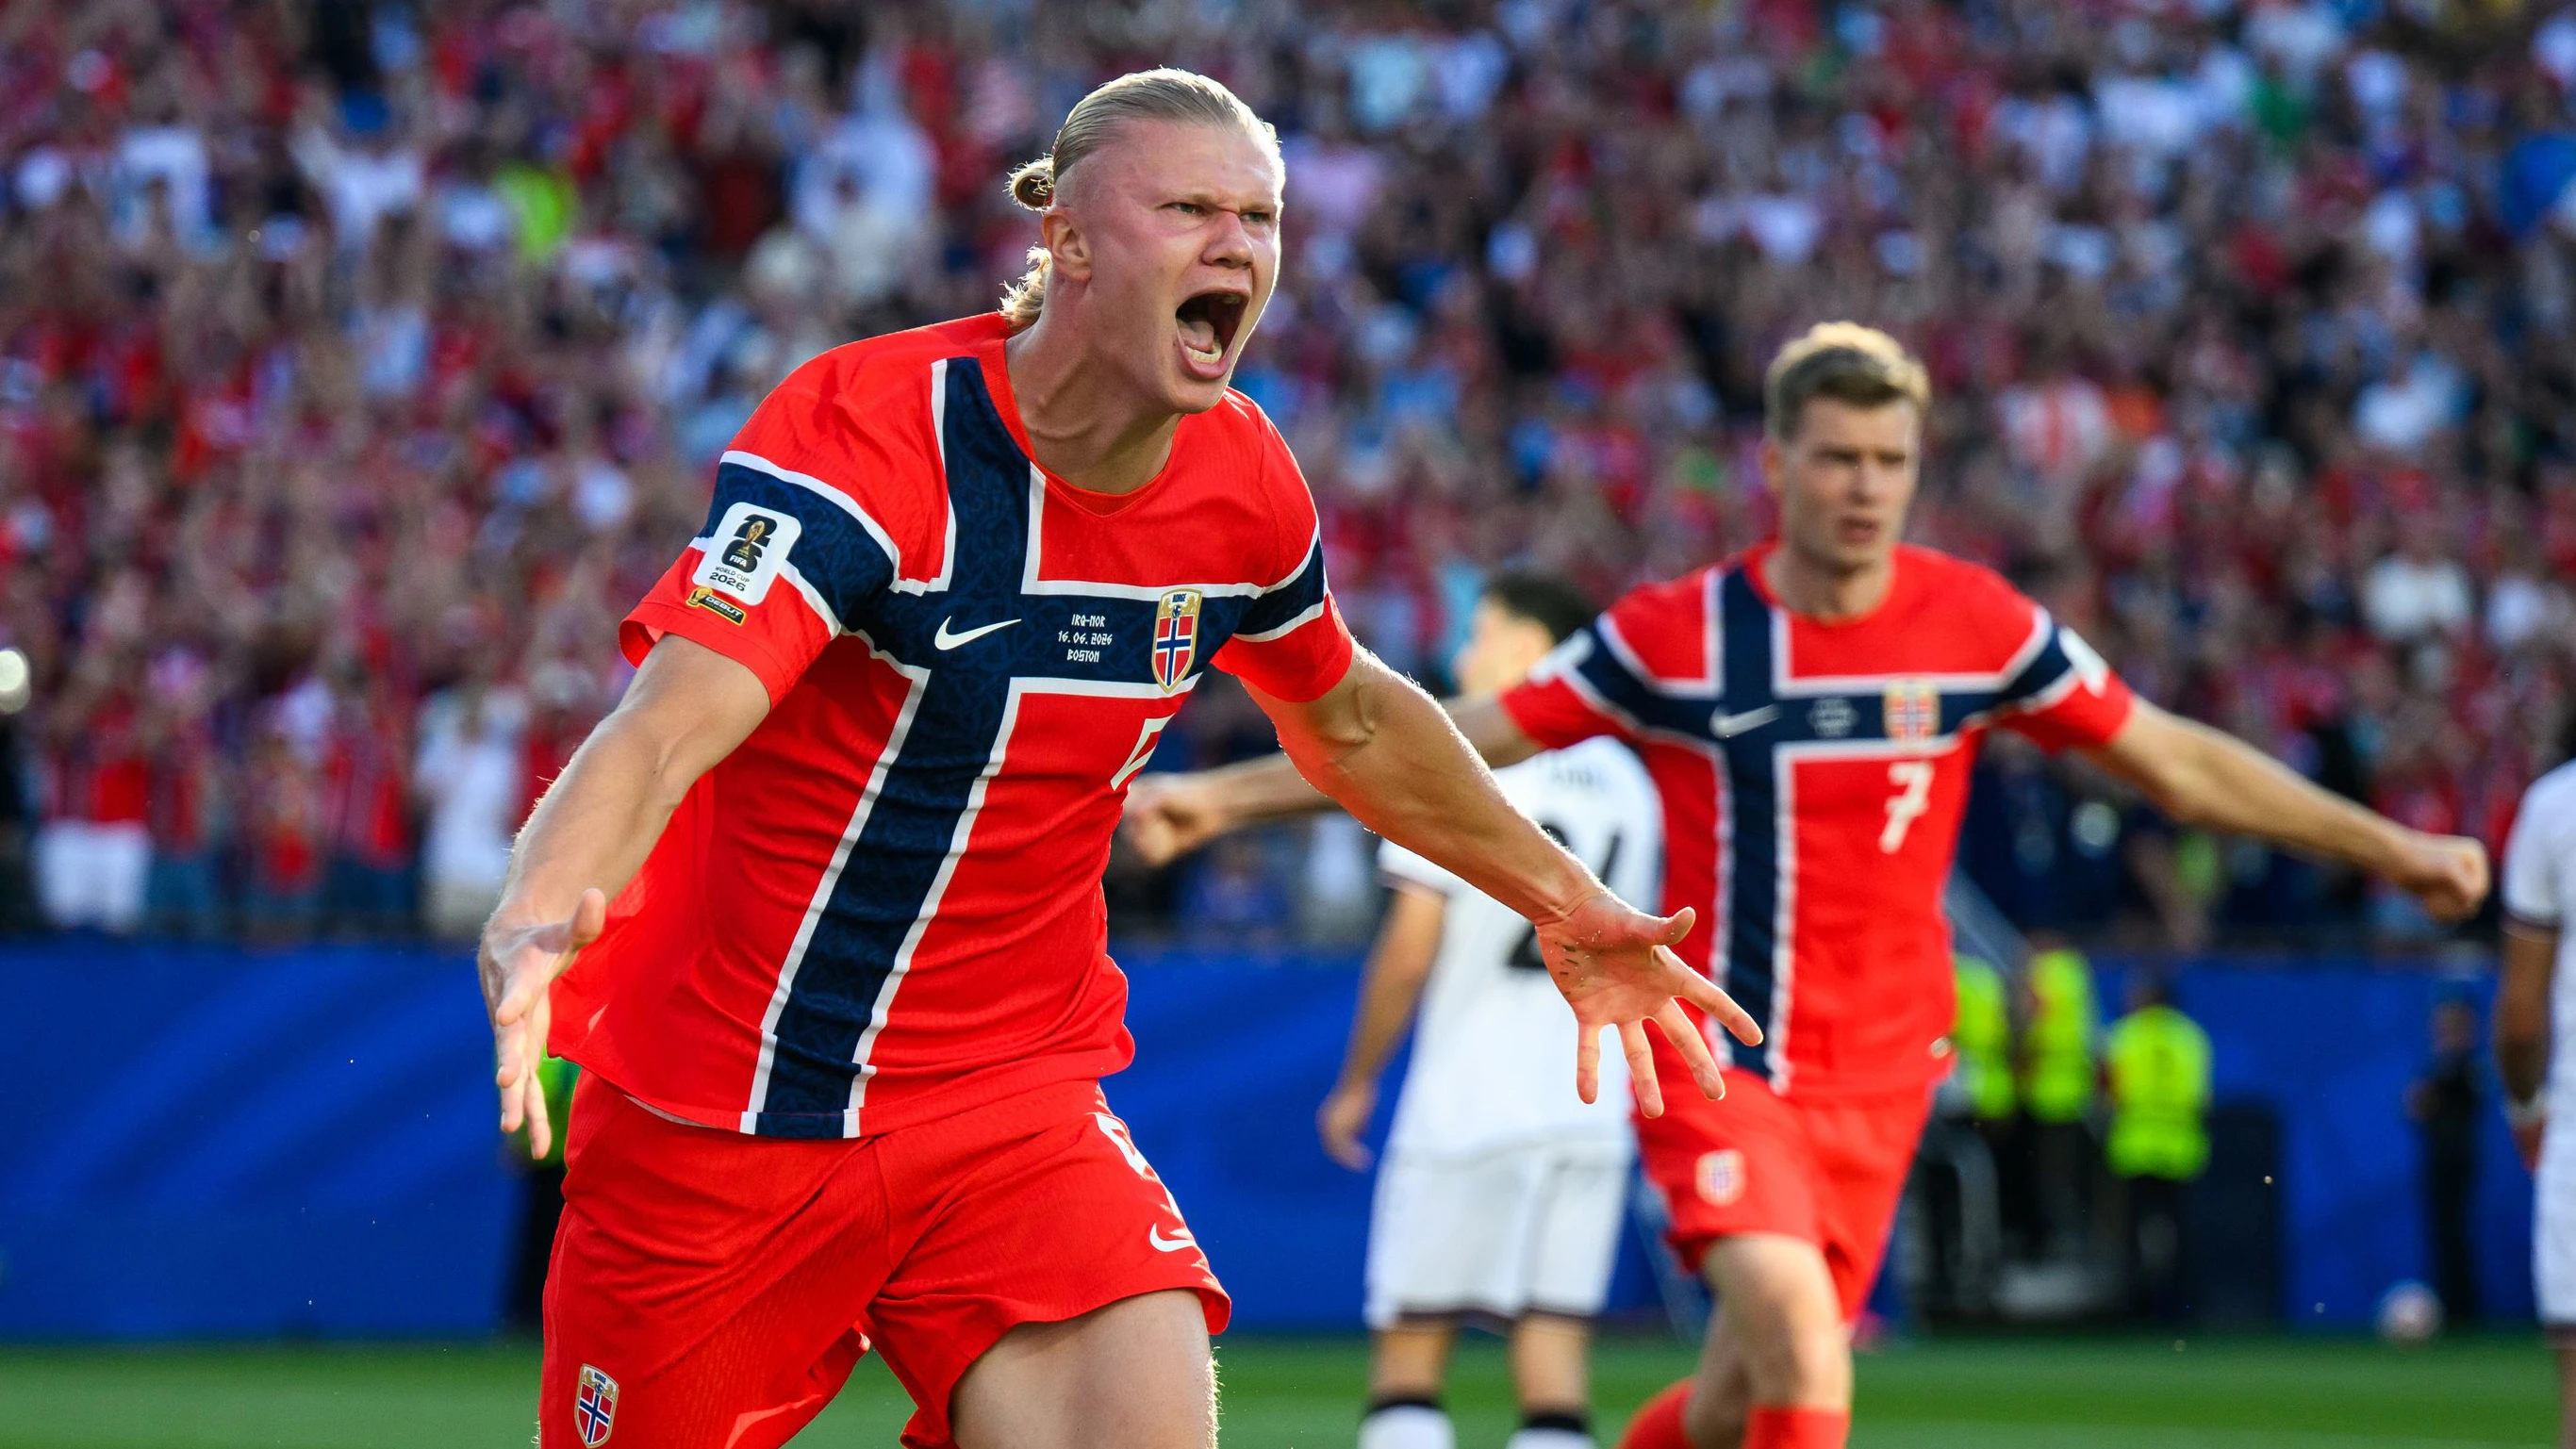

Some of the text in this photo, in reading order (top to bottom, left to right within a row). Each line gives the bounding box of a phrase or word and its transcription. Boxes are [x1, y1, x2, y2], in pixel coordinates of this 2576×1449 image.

[729, 554, 748, 568] FIFA
[709, 571, 747, 592] 2026
[715, 566, 751, 583] WORLD CUP
[705, 596, 743, 617] DEBUT
[1071, 614, 1106, 627] IRQ-NOR
[1066, 649, 1100, 663] BOSTON
[1879, 760, 1934, 854] 7
